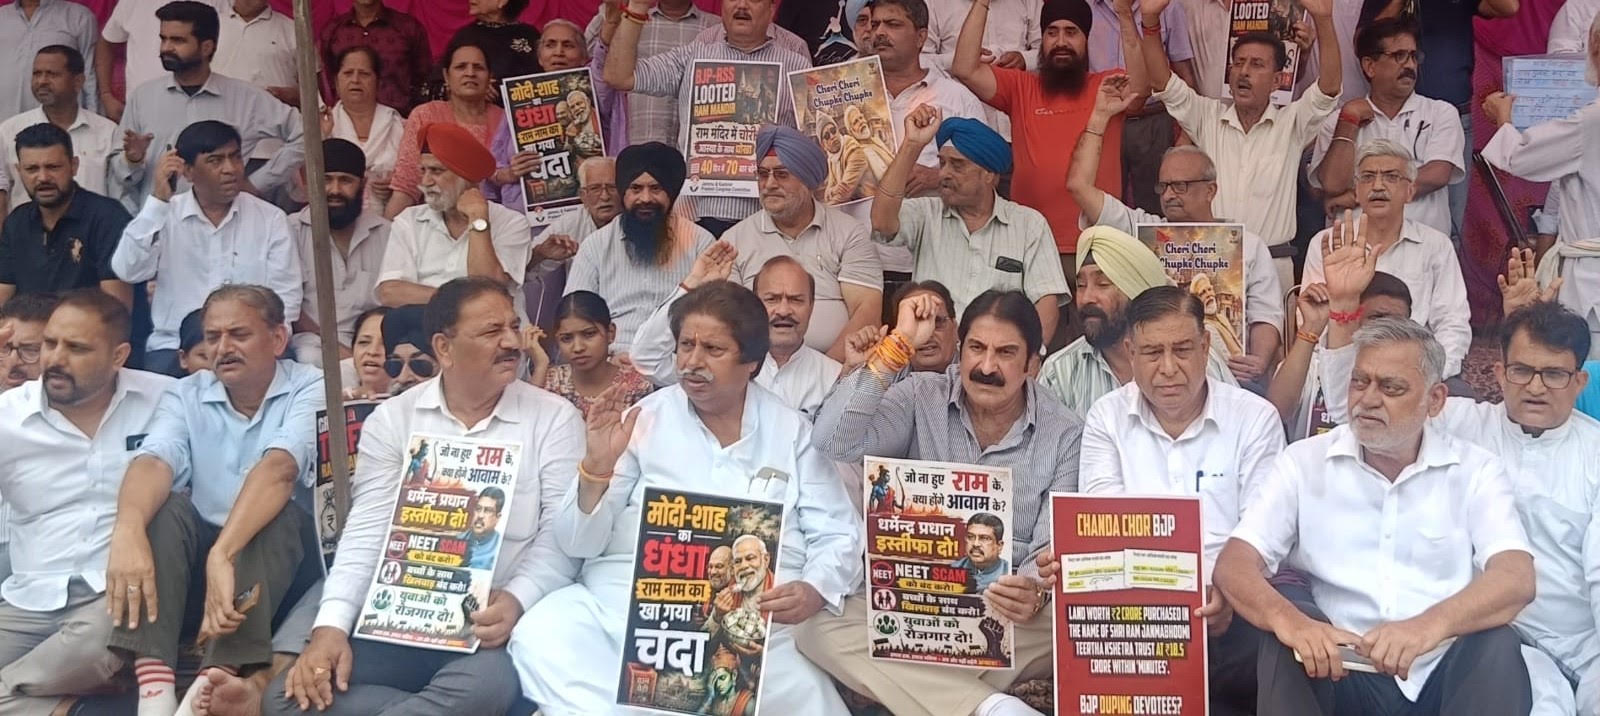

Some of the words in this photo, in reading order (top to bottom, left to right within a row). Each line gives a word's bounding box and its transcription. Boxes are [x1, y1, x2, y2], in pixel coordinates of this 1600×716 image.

[1233, 3, 1269, 20] LOOTED
[695, 66, 736, 84] BJP-RSS
[510, 80, 560, 100] मोदी-शाह
[694, 83, 736, 104] LOOTED
[843, 89, 873, 102] Chupke
[515, 104, 556, 128] धंधा
[696, 127, 709, 140] राम
[711, 125, 730, 140] मंदिर
[701, 160, 713, 175] 40
[726, 160, 738, 175] 70
[1194, 258, 1229, 272] Chupke
[440, 443, 450, 457] जो
[451, 447, 460, 458] ना
[476, 446, 505, 467] राम
[467, 468, 501, 485] आवाम
[904, 468, 916, 483] जो
[918, 473, 929, 484] ना
[931, 473, 945, 489] हुए
[952, 470, 989, 493] राम
[439, 492, 470, 508] प्रधान
[946, 494, 990, 511] आवाम
[401, 504, 449, 526] इस्तीफा
[449, 508, 469, 528] दो!
[647, 494, 728, 533] मोदी-शाह
[918, 520, 956, 537] प्रधान
[1076, 513, 1121, 537] CHANDA
[1122, 513, 1151, 537] CHOR
[1152, 514, 1175, 537] BJP
[408, 534, 440, 551] NEET
[677, 529, 692, 542] का
[389, 541, 407, 551] NEET
[875, 533, 934, 555] इस्तीफा
[935, 536, 959, 558] दो!
[643, 537, 710, 579] धंधा
[872, 568, 893, 580] NEET
[895, 563, 930, 580] NEET
[932, 567, 968, 584] SCAM
[641, 581, 662, 598] राम
[663, 583, 688, 599] नाम
[688, 584, 706, 600] का
[433, 593, 447, 606] को
[395, 604, 436, 620] रोजगार
[437, 608, 455, 622] दो!
[638, 602, 661, 621] खा
[662, 603, 692, 622] गया
[1068, 606, 1086, 621] LAND
[1086, 606, 1111, 621] WORTH
[1111, 606, 1121, 621] ₹2
[1121, 606, 1142, 621] CRORE
[1143, 606, 1181, 621] PURCHASED
[1181, 606, 1189, 621] IN
[903, 615, 941, 629] युवाओं
[943, 618, 960, 629] को
[904, 625, 952, 642] रोजगार
[953, 630, 973, 644] दो!
[1069, 624, 1081, 638] THE
[1081, 624, 1099, 638] NAME
[1100, 624, 1110, 638] OF
[1110, 624, 1125, 638] SHRI
[1125, 624, 1140, 639] RAM
[1141, 624, 1191, 640] JANMABHOOMI
[634, 621, 711, 677] चंदा
[1075, 641, 1104, 656] TEERTHA
[1104, 642, 1134, 656] KSHETRA
[1135, 642, 1155, 656] TRUST
[1156, 642, 1164, 657] AT
[1090, 659, 1112, 674] CRORE
[1112, 659, 1137, 674] WITHIN
[1079, 695, 1098, 714] BJP
[1099, 695, 1133, 714] DUPING
[1133, 696, 1183, 715] DEVOTEES?
